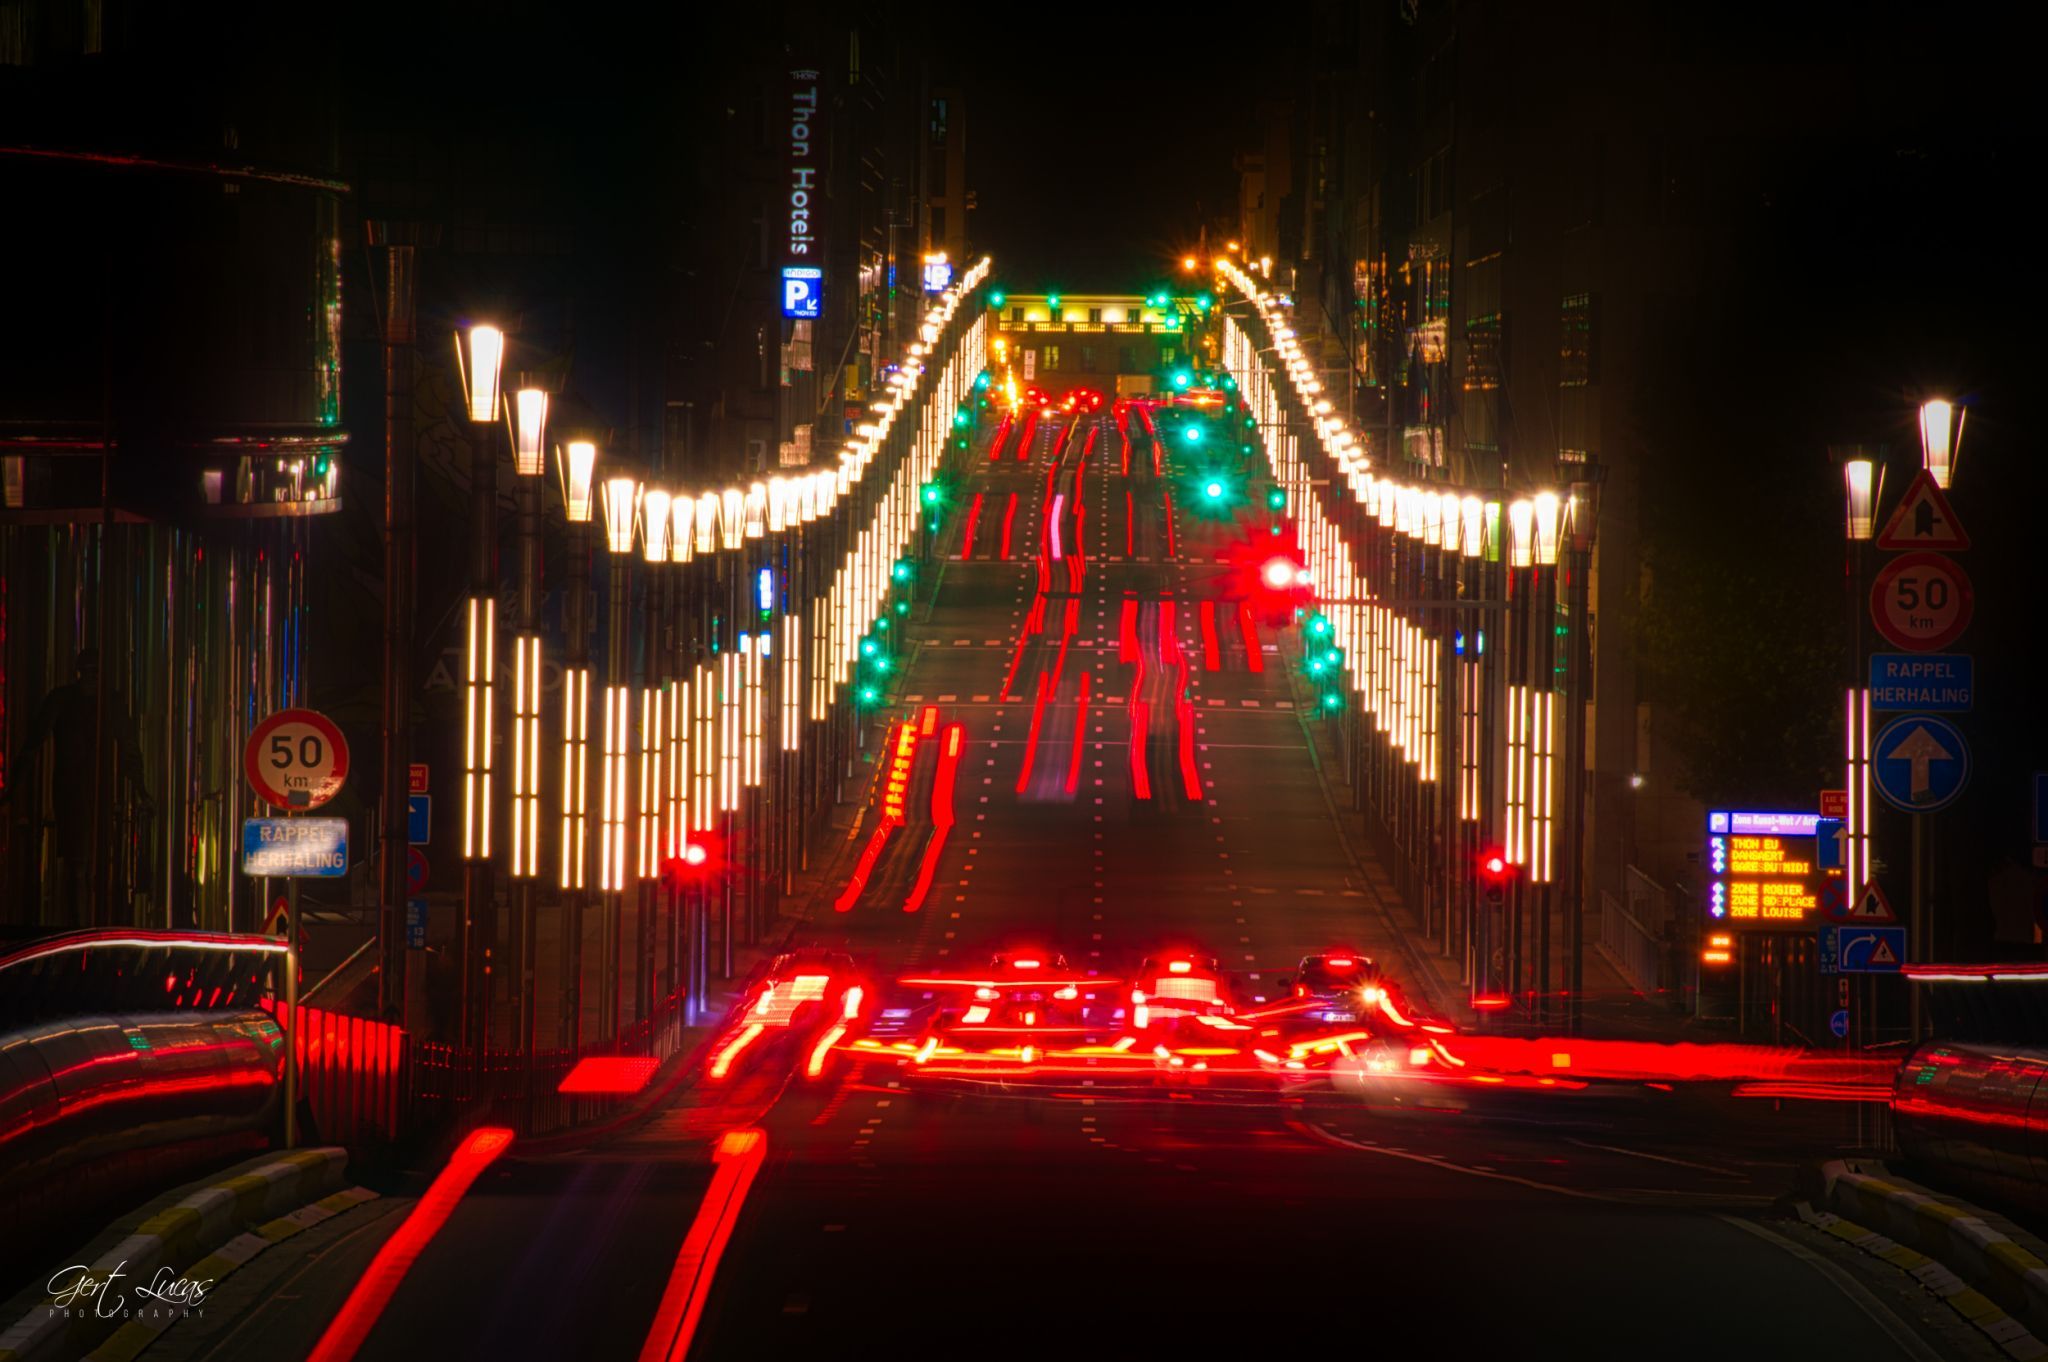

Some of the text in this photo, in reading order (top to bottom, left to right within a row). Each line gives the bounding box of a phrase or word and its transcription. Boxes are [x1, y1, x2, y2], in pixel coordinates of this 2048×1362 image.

[791, 86, 817, 255] Thon Hotels
[786, 280, 809, 310] P
[1898, 578, 1948, 610] 50
[1910, 615, 1934, 629] km
[1887, 662, 1956, 678] RAPPEL
[1873, 687, 1969, 704] HERHALING
[271, 735, 322, 769] 50
[284, 774, 308, 787] km
[1711, 814, 1725, 830] P
[260, 826, 329, 842] RAPPEL
[1732, 838, 1779, 850] THON EU
[246, 851, 344, 868] HERHALING
[1732, 850, 1784, 861] DANSAERT
[1783, 863, 1809, 873] MIDI
[1731, 883, 1758, 894] ZONE
[1731, 894, 1758, 906] ZONE
[1782, 896, 1816, 908] PLACE
[1731, 906, 1803, 918] ZONE LOUISE
